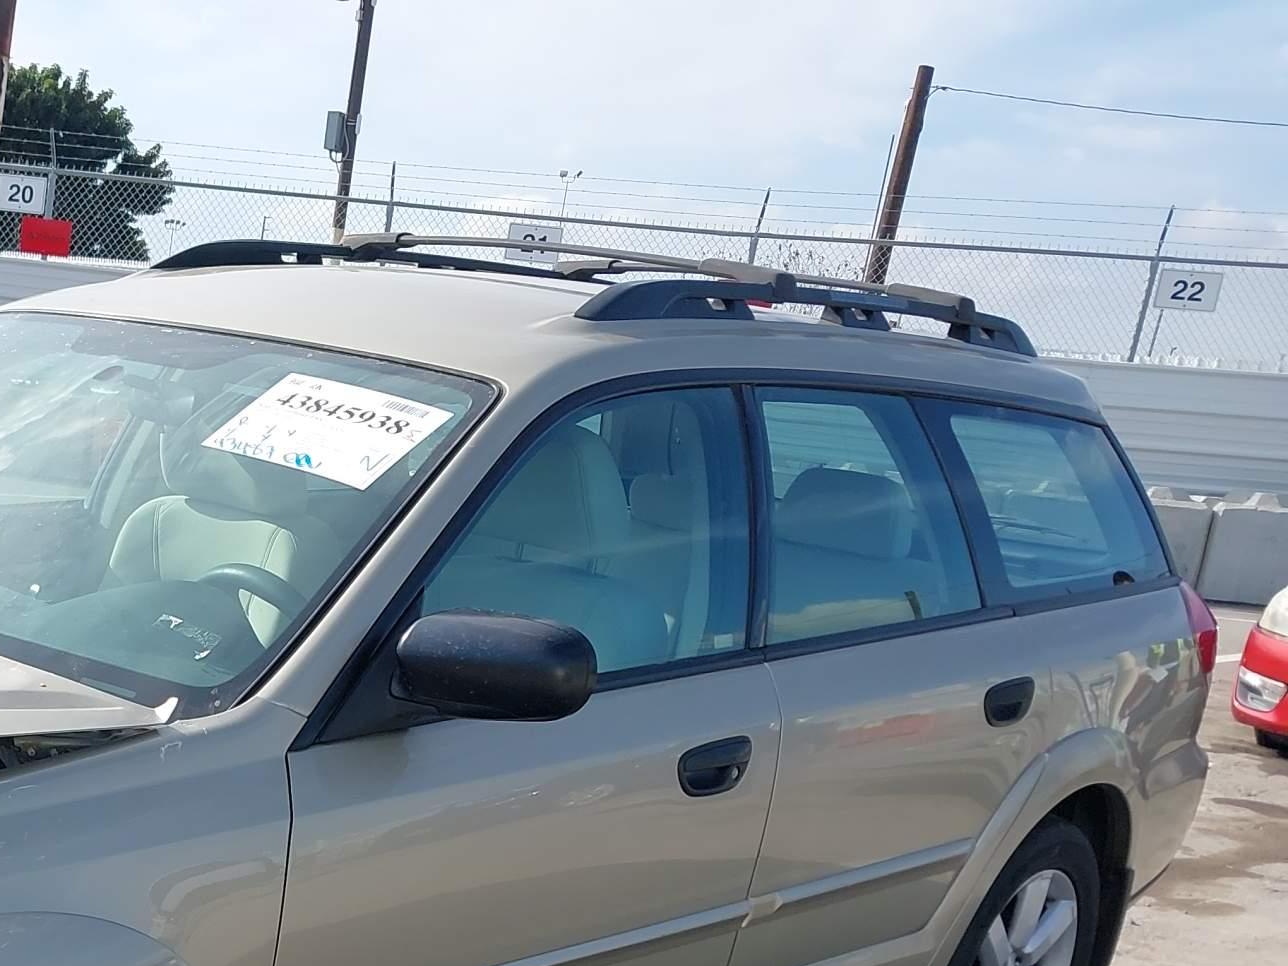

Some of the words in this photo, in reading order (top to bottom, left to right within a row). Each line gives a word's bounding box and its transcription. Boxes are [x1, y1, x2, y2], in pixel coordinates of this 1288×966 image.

[8, 184, 33, 203] 20
[1170, 280, 1205, 302] 22
[277, 393, 410, 434] 43845938
